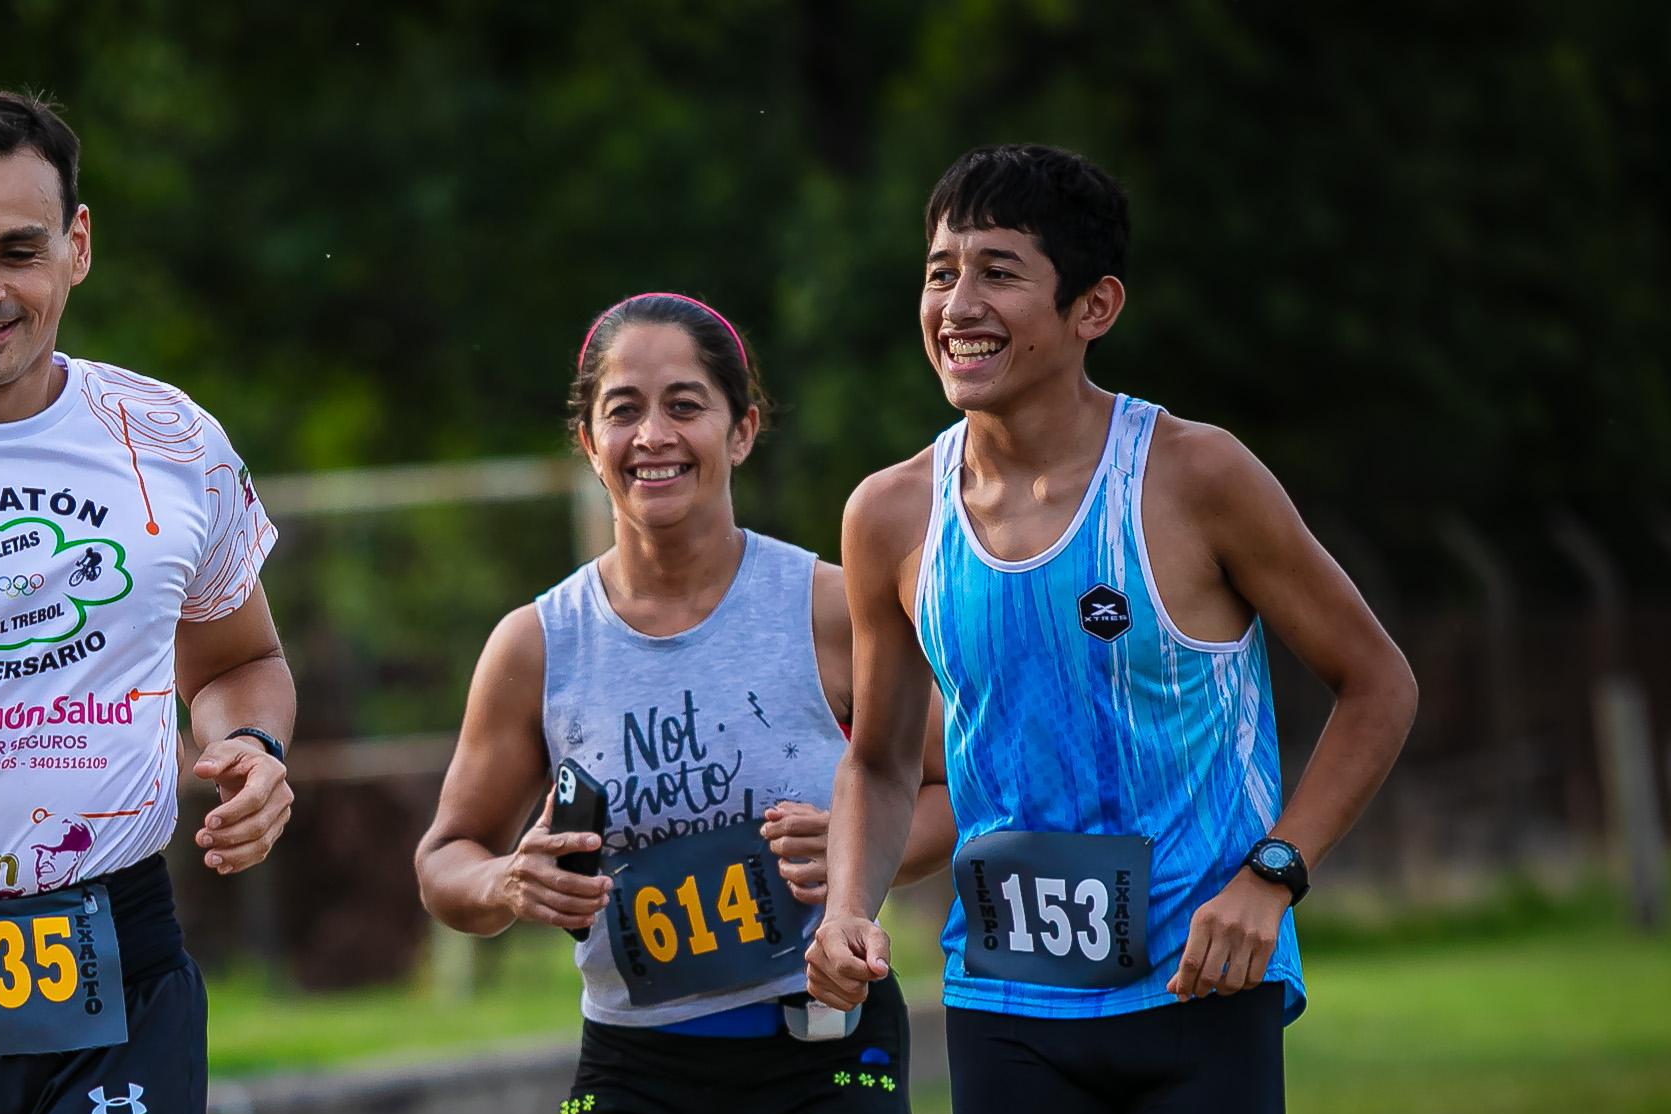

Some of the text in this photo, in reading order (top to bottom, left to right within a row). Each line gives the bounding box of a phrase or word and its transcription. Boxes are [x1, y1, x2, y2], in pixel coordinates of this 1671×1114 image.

[10, 603, 65, 631] TREBOL
[9, 734, 88, 752] SEGUROS
[29, 756, 108, 770] 3401516109
[623, 689, 707, 773] Not
[634, 862, 765, 963] 614
[969, 859, 999, 951] TIEMPO
[1000, 873, 1111, 962] 153
[1113, 869, 1134, 968] EXACTO
[74, 914, 104, 1016] EXACTO
